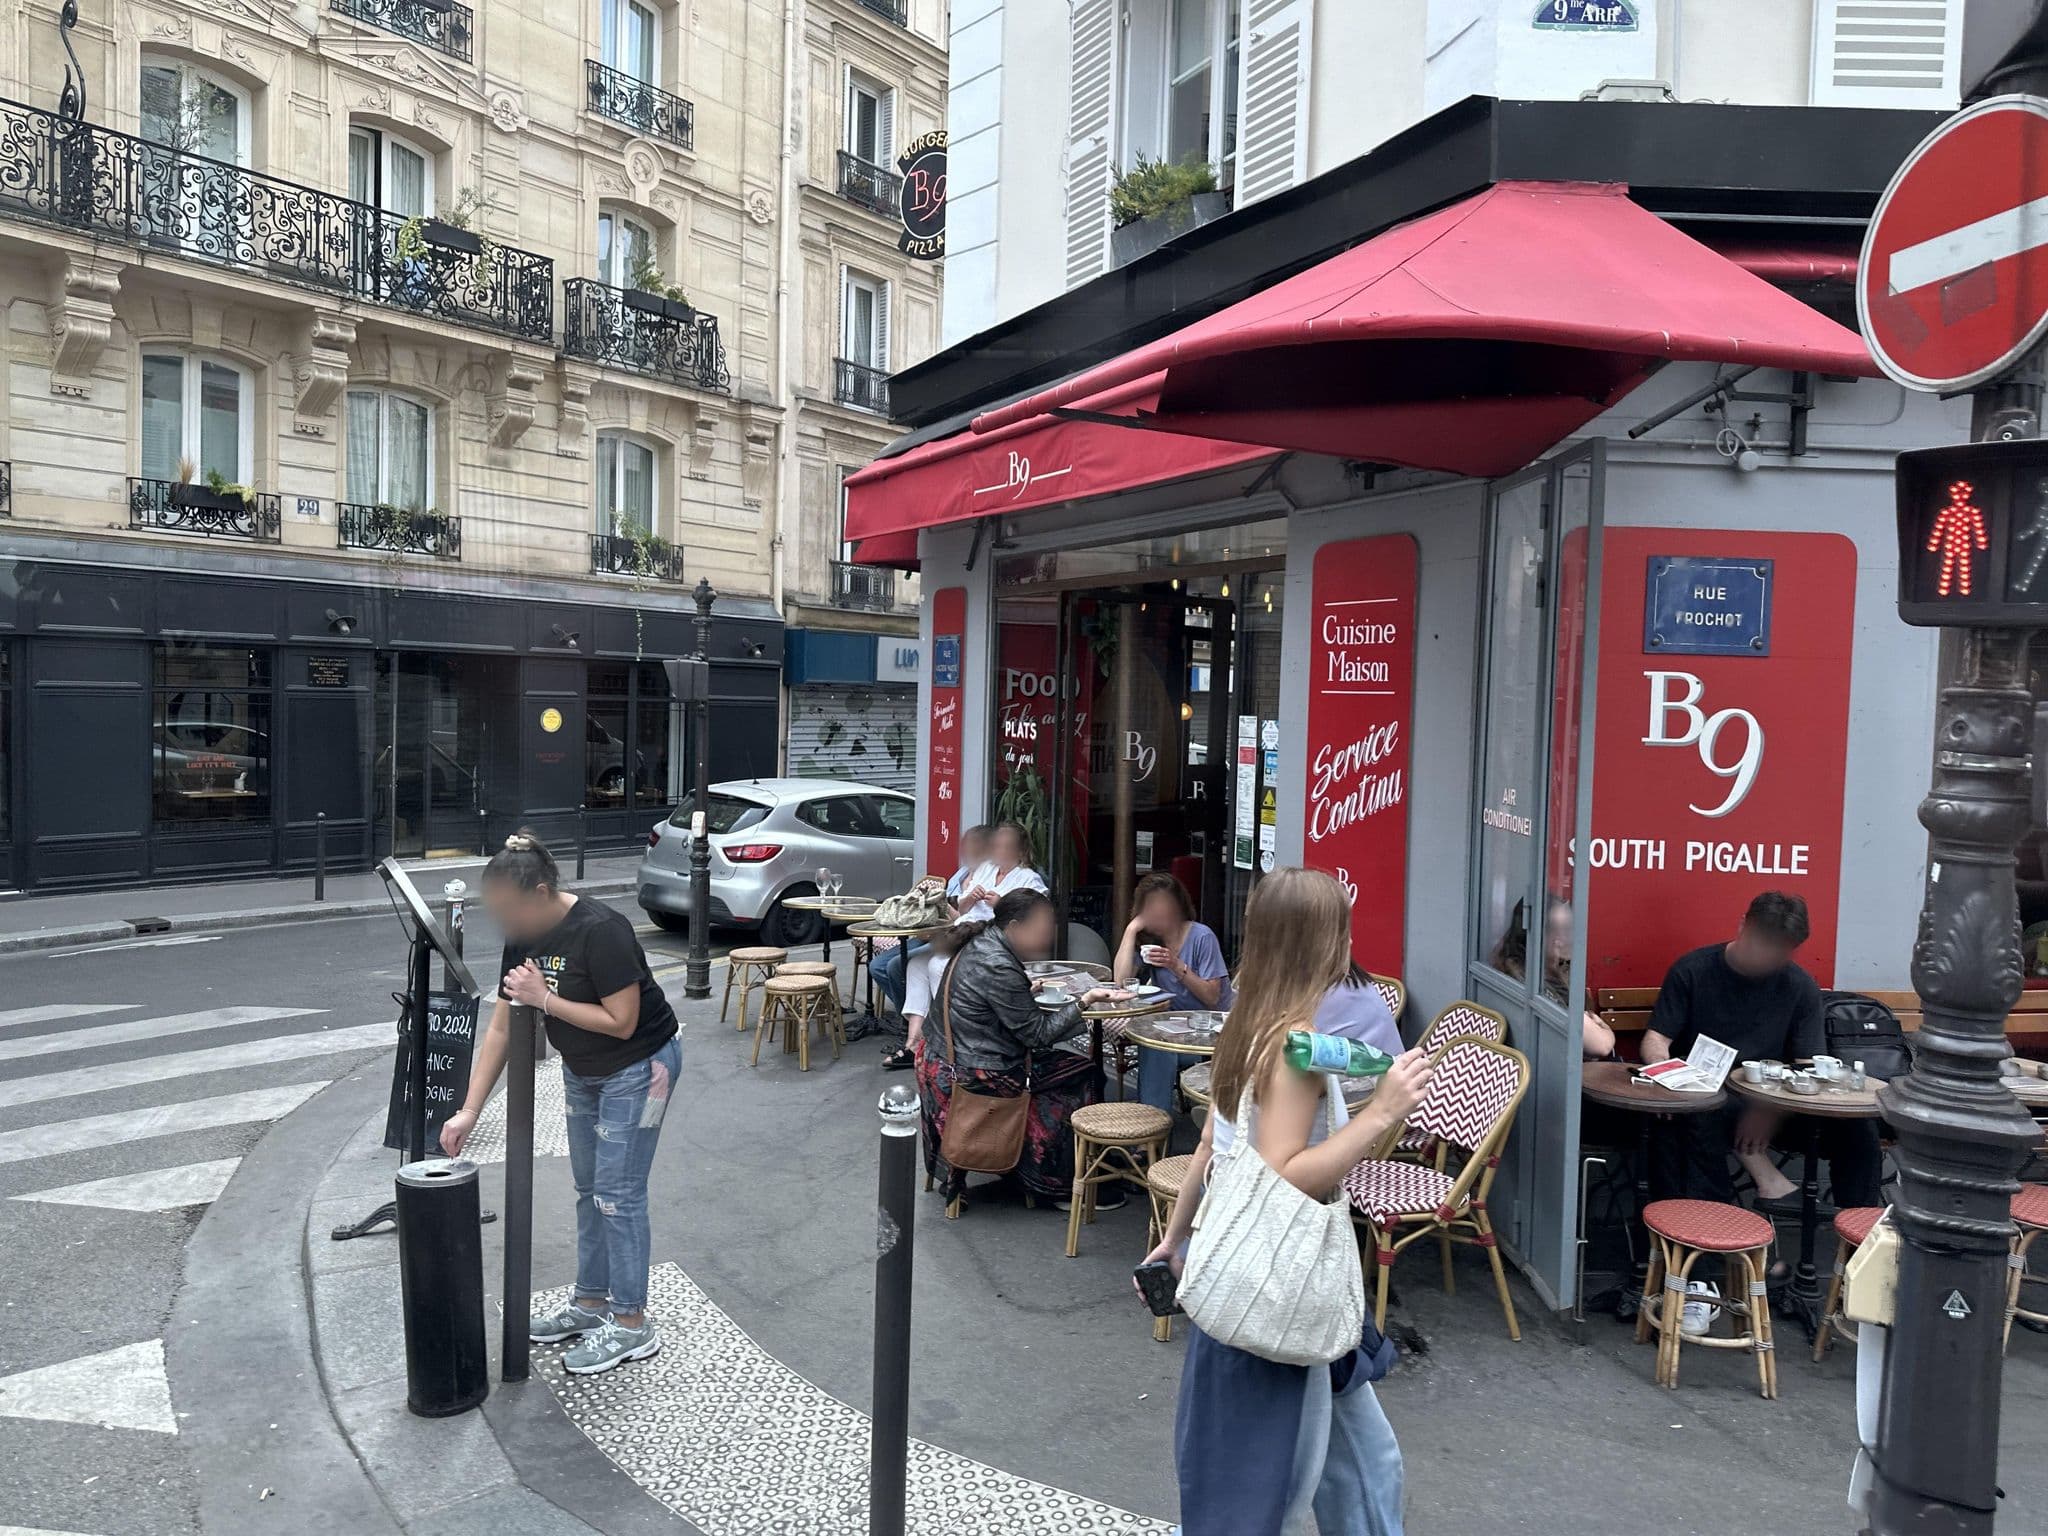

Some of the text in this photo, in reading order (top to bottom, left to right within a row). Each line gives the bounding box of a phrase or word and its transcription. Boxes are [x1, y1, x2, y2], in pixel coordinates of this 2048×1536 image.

[910, 169, 946, 221] B9
[1008, 451, 1030, 500] B9
[300, 499, 317, 515] 29
[1694, 587, 1727, 600] RUE
[1323, 615, 1396, 645] Cuisine
[1328, 651, 1389, 682] Maison
[1005, 721, 1037, 740] PLATS
[1641, 671, 1764, 818] B9
[1123, 731, 1157, 782] B9
[1312, 721, 1399, 802] Service
[1309, 769, 1403, 842] Continu
[1502, 788, 1516, 806] AIR
[941, 820, 949, 844] B9
[1686, 841, 1809, 875] PIGALLE
[442, 1015, 472, 1039] 2024
